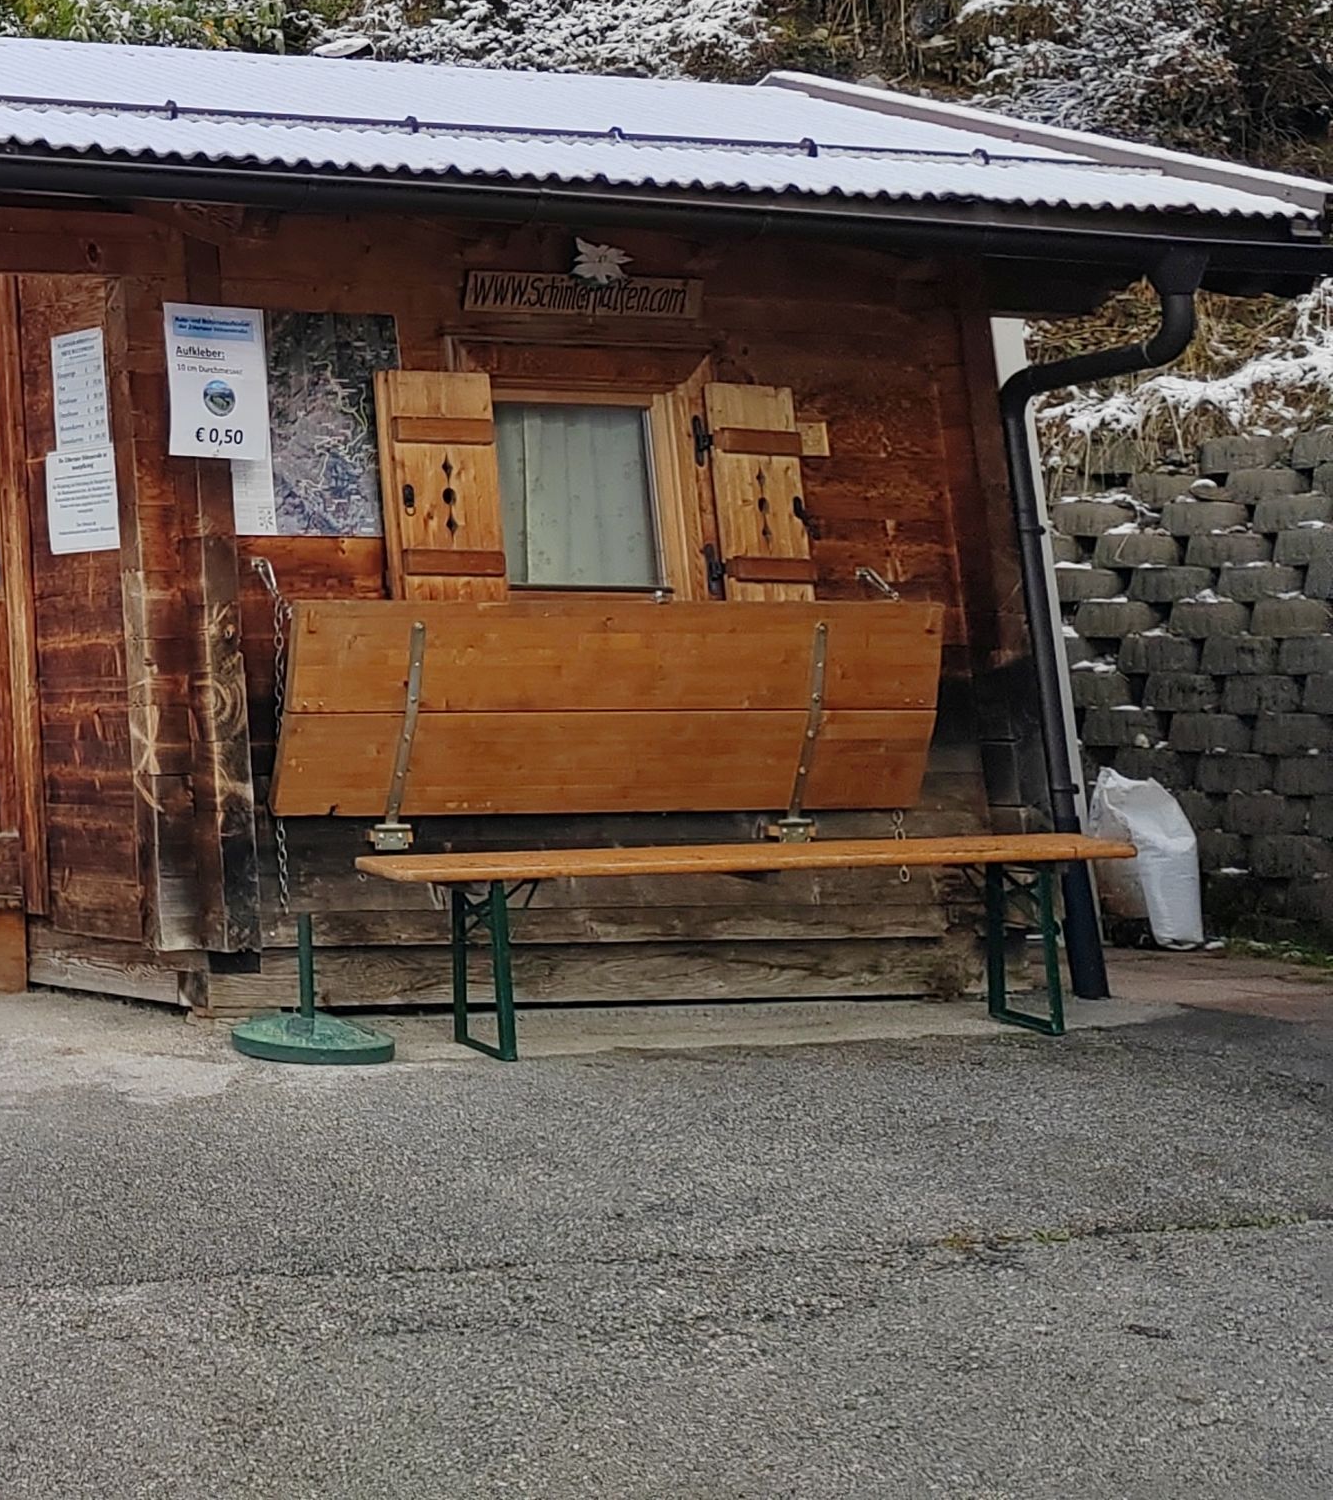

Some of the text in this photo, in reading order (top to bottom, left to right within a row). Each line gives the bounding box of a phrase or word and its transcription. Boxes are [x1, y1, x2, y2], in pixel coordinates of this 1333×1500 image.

[176, 346, 225, 360] Aufkleber:
[195, 427, 244, 446] € 0,50
